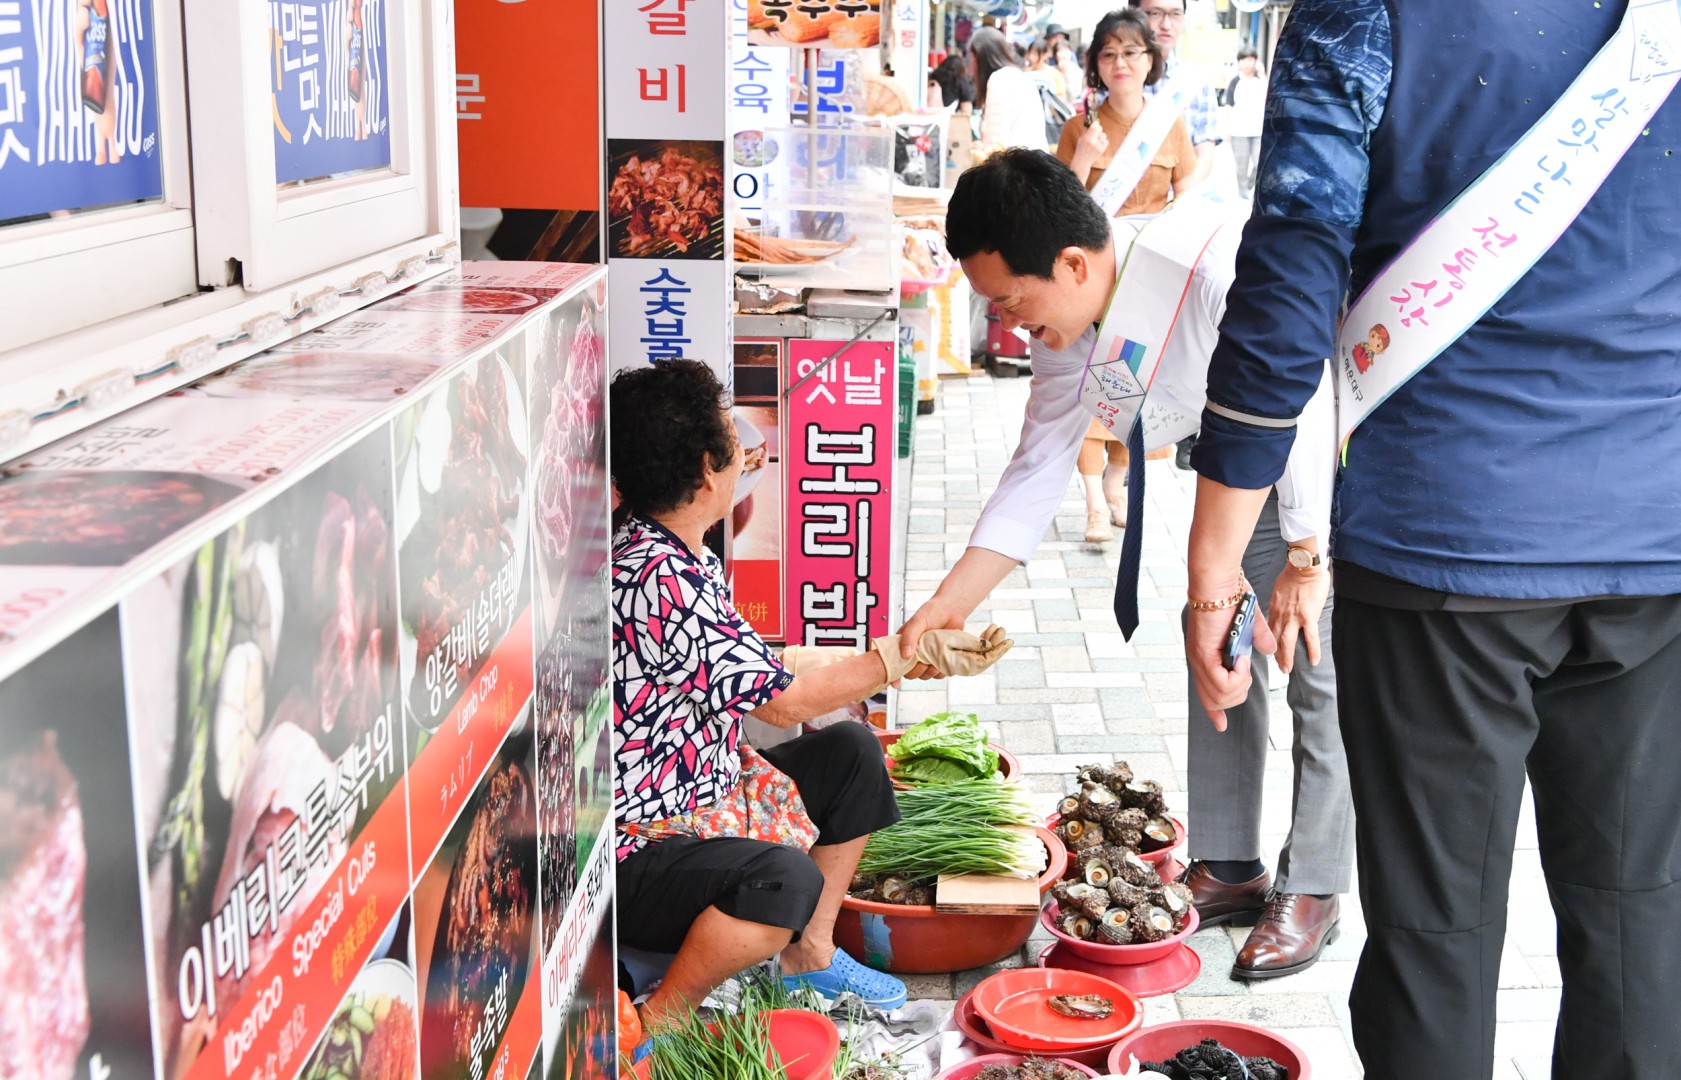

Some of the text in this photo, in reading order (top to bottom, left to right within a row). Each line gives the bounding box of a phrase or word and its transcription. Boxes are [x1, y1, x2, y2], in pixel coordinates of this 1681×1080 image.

[299, 67, 322, 145] 맛
[1512, 88, 1629, 215] 살맛나는
[639, 267, 692, 364] 숯불
[1389, 216, 1518, 328] 전통시장
[797, 358, 886, 405] 옛날
[1344, 358, 1364, 402] 해운대구
[800, 422, 881, 652] 보리밥
[457, 664, 498, 736] Lamb Chop
[178, 702, 395, 1022] 이베리코특수부위
[223, 840, 376, 1078] Iberico Special Cuts
[469, 966, 508, 1080] 불족발
